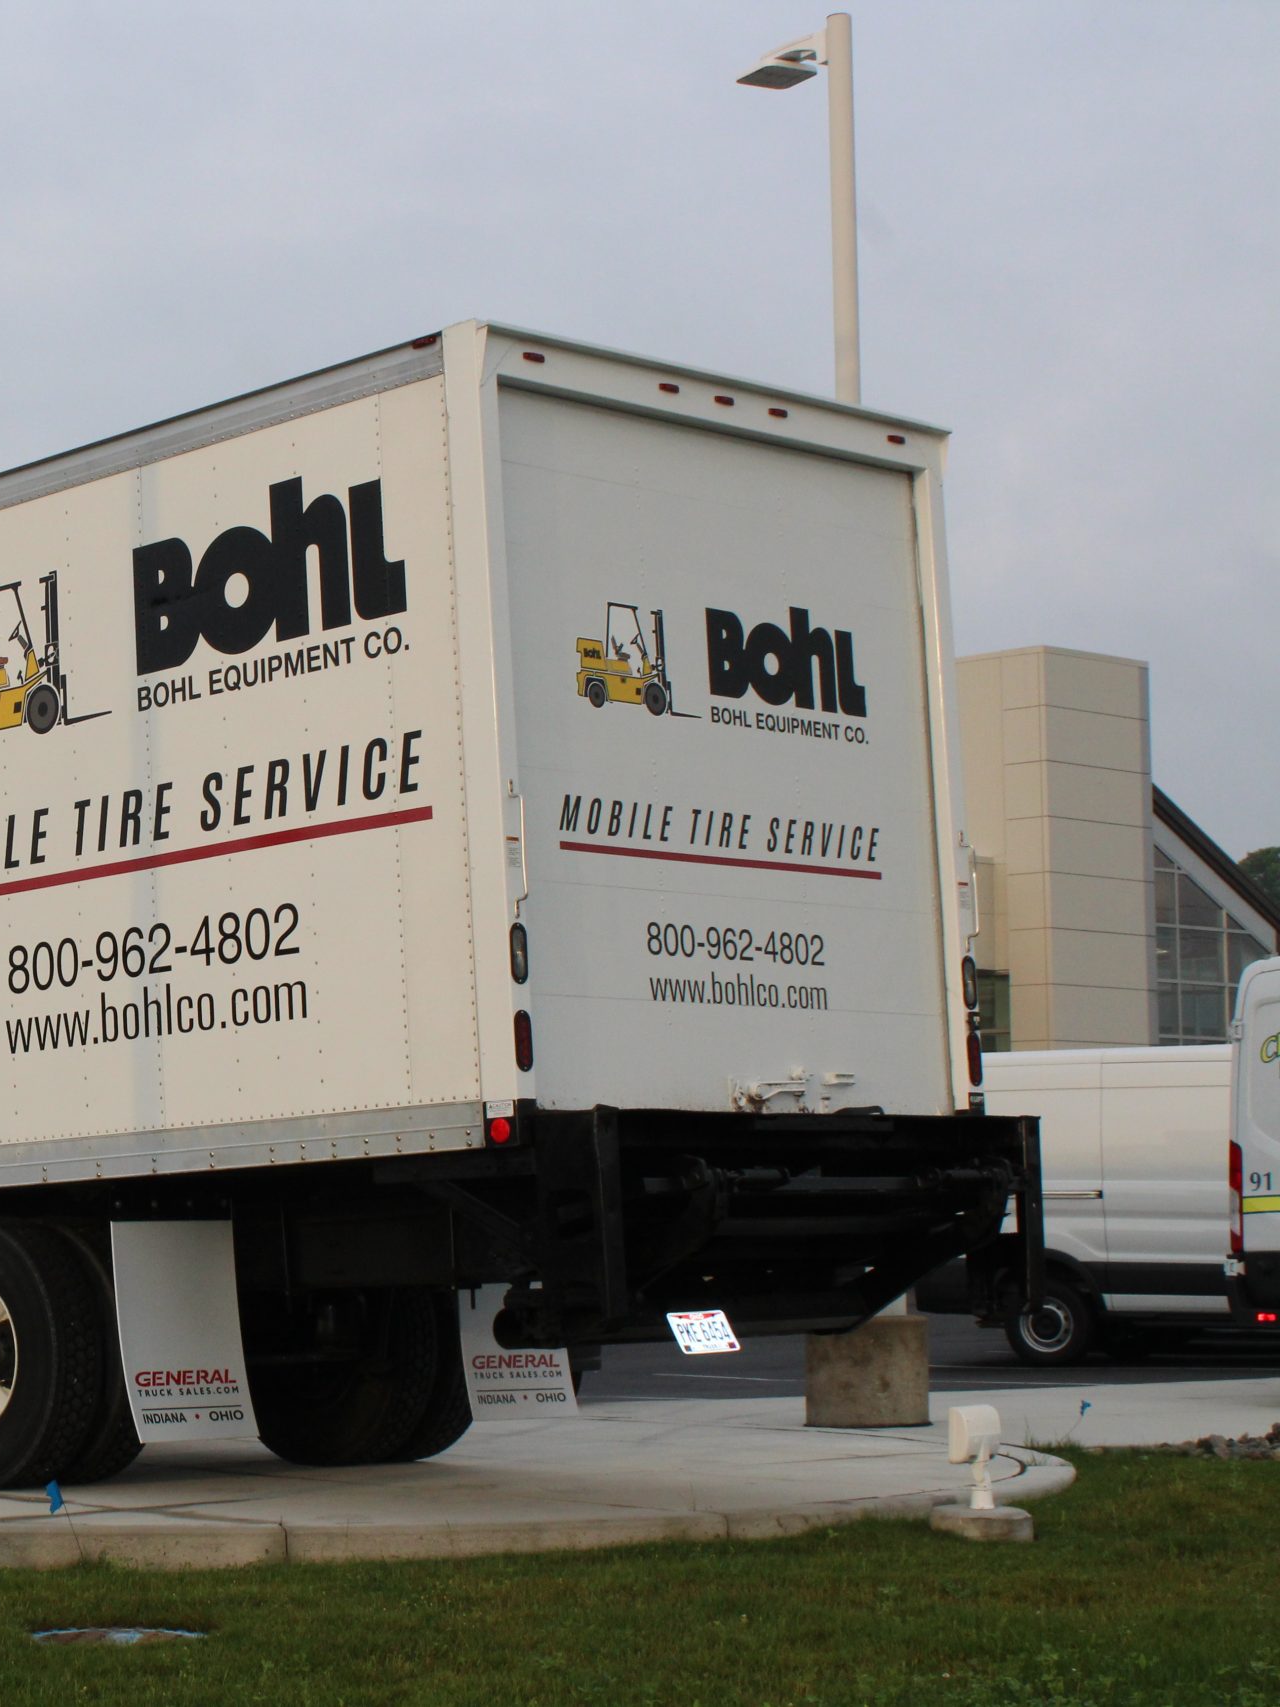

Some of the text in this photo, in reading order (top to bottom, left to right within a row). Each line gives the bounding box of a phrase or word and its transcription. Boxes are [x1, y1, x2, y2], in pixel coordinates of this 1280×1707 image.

[137, 627, 410, 712] BOHL EQUIPMENT CO.
[710, 705, 869, 745] BOHL EQUIPMENT CO.
[74, 782, 173, 856] TIRE
[200, 730, 422, 832] SERVICE
[559, 794, 880, 862] MOBILE TIRE SERVICE
[7, 902, 300, 994] 800-962-4802
[646, 921, 825, 967] 800-962-4802
[649, 971, 828, 1010] www.bohlco.com
[6, 980, 308, 1055] www.bohlco.com
[135, 1369, 237, 1387] GENERAL
[472, 1354, 560, 1369] GENERAL
[474, 1370, 562, 1379] TRUCK SALES.COM
[137, 1386, 239, 1397] TRUCK SALES.COM
[477, 1392, 566, 1405] INDIANA OHIO
[142, 1409, 244, 1424] INDIANA OHIO
